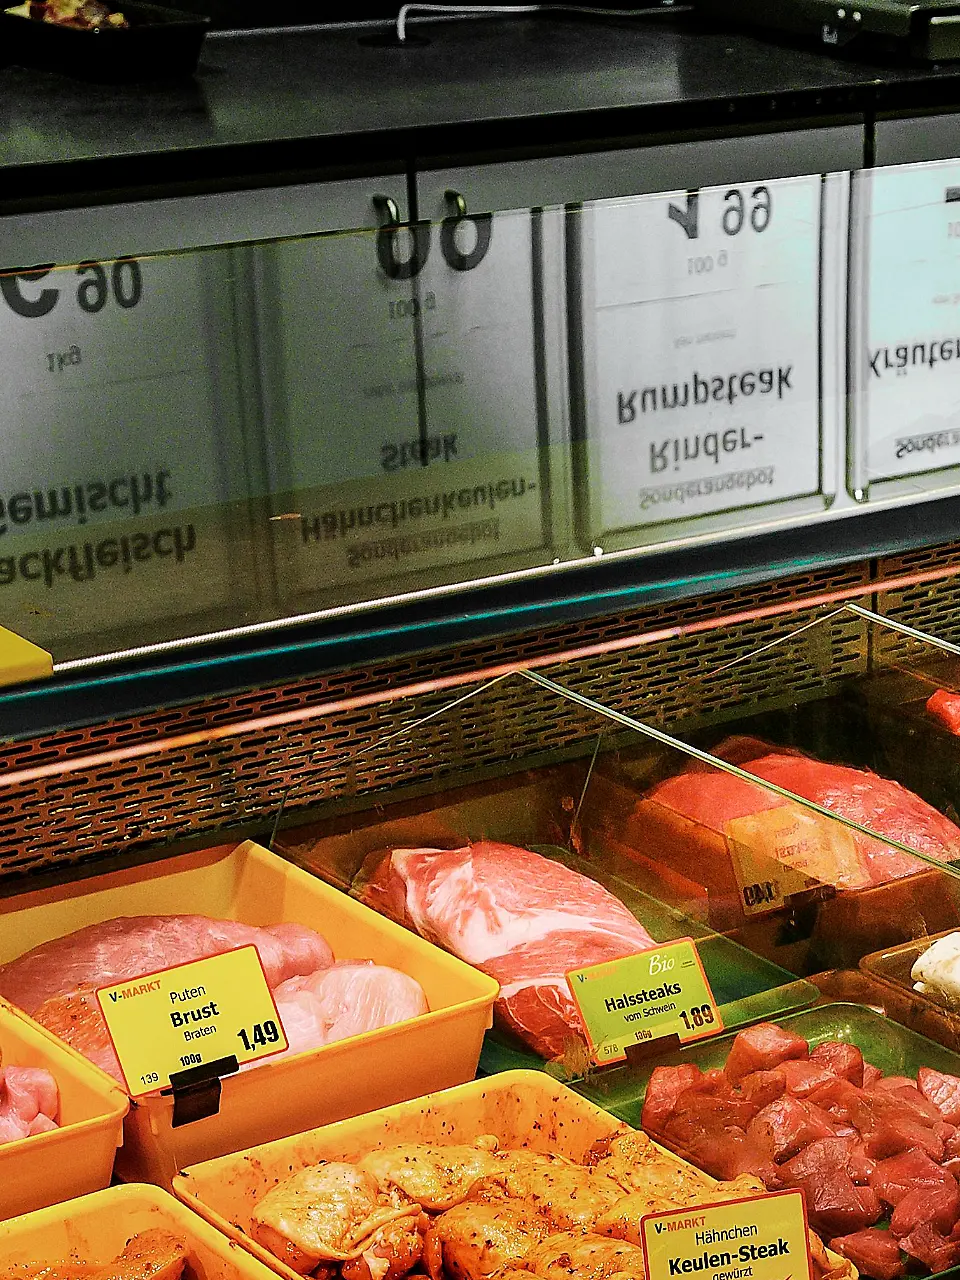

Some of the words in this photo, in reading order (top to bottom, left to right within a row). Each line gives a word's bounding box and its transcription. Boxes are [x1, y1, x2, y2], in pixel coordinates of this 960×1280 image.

[649, 954, 675, 976] Bio
[109, 980, 161, 1003] V-MARKT
[170, 986, 206, 1004] Puten
[604, 982, 682, 1012] Halssteaks
[170, 1001, 219, 1027] Brust
[624, 1011, 642, 1023] vom
[643, 1002, 676, 1017] Schwein
[679, 1004, 714, 1030] 1,89
[184, 1024, 217, 1042] Braten
[237, 1020, 279, 1051] 1,49
[180, 1054, 202, 1067] 100g
[604, 1045, 618, 1055] 578
[141, 1072, 159, 1085] 139
[654, 1216, 706, 1234] V-MARKT
[695, 1225, 758, 1245] Hähnchen
[668, 1238, 790, 1276] Keulen-Steak
